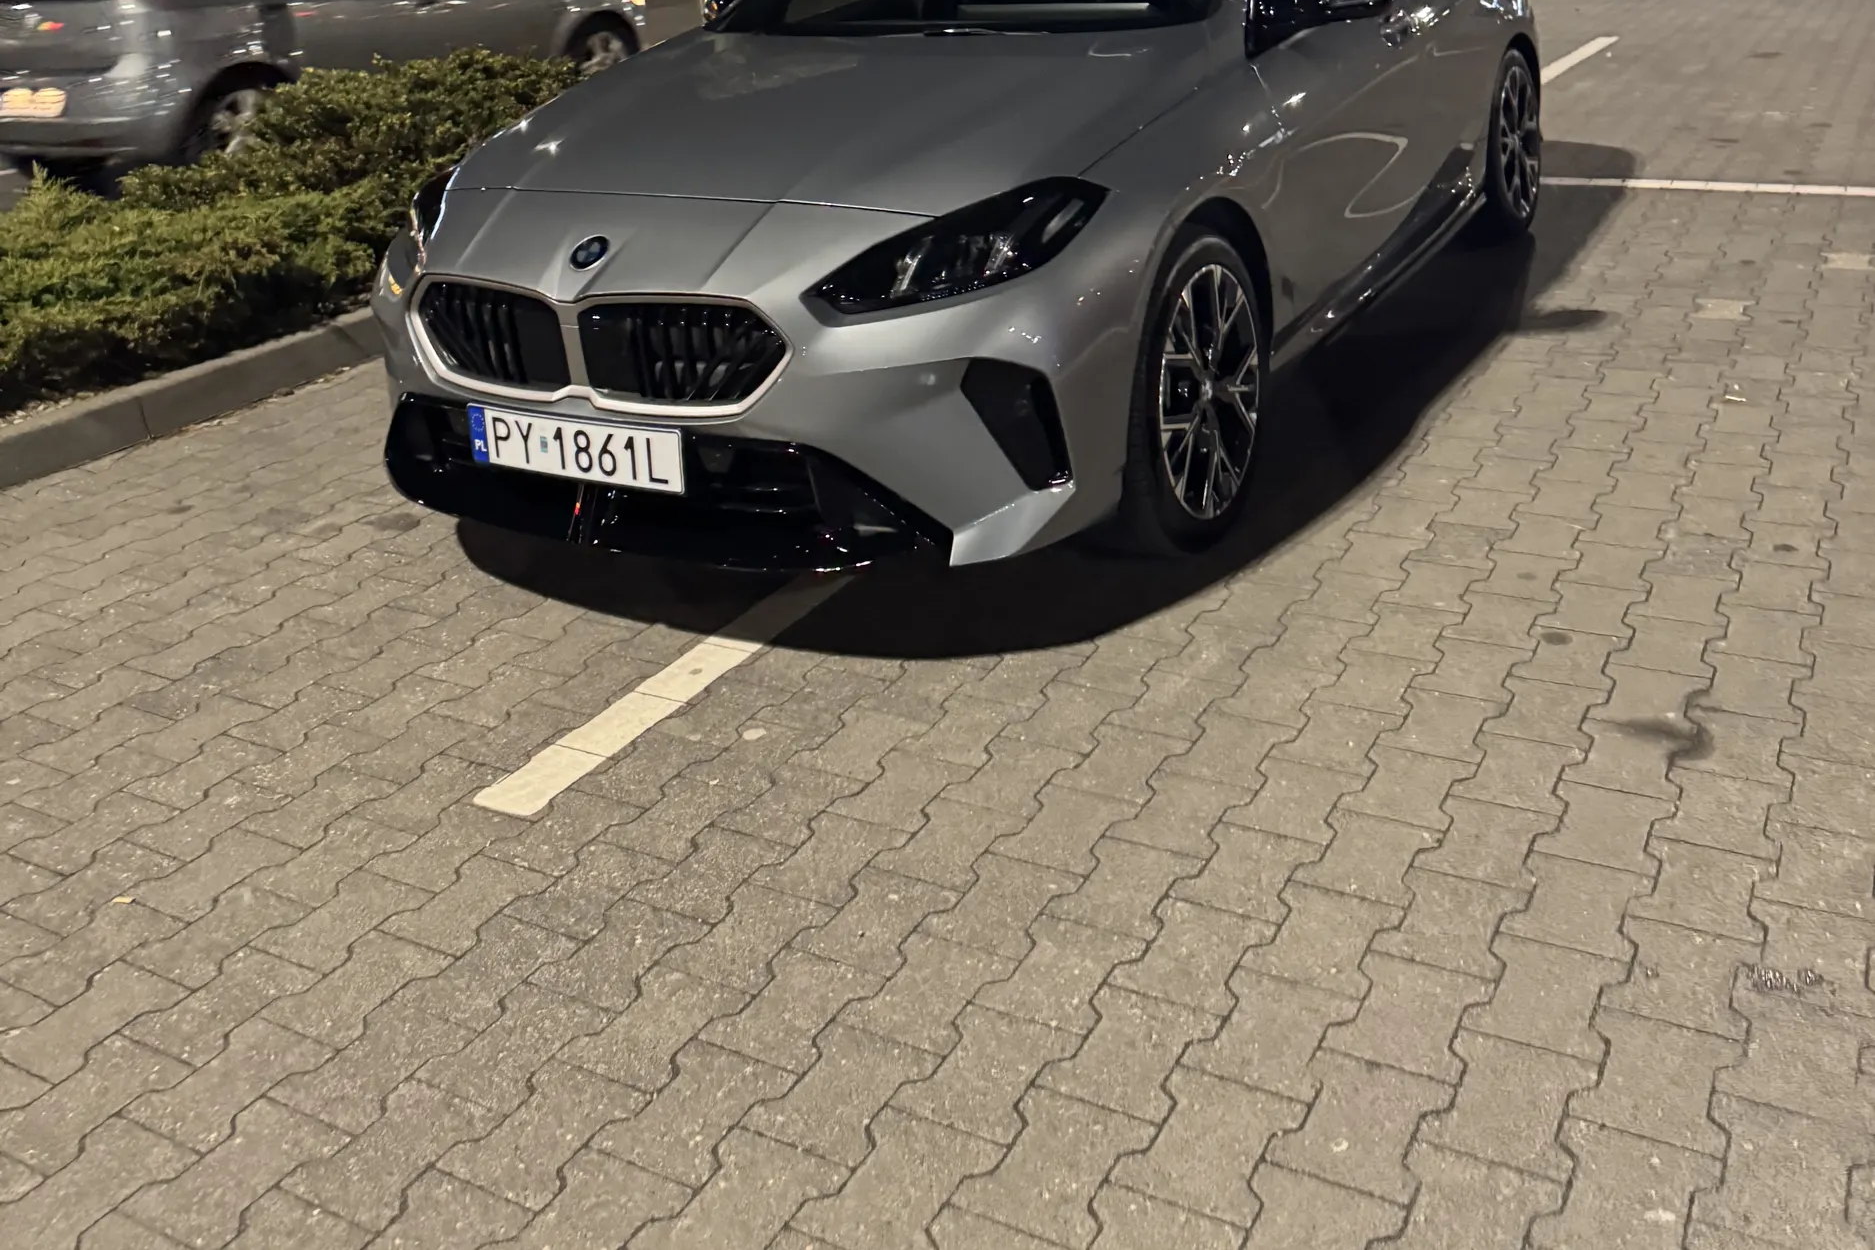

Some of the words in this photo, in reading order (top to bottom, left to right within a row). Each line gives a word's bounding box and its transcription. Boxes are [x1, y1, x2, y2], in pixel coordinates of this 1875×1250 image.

[474, 439, 487, 452] PL
[491, 416, 532, 465] PY
[552, 426, 669, 485] 1861L
